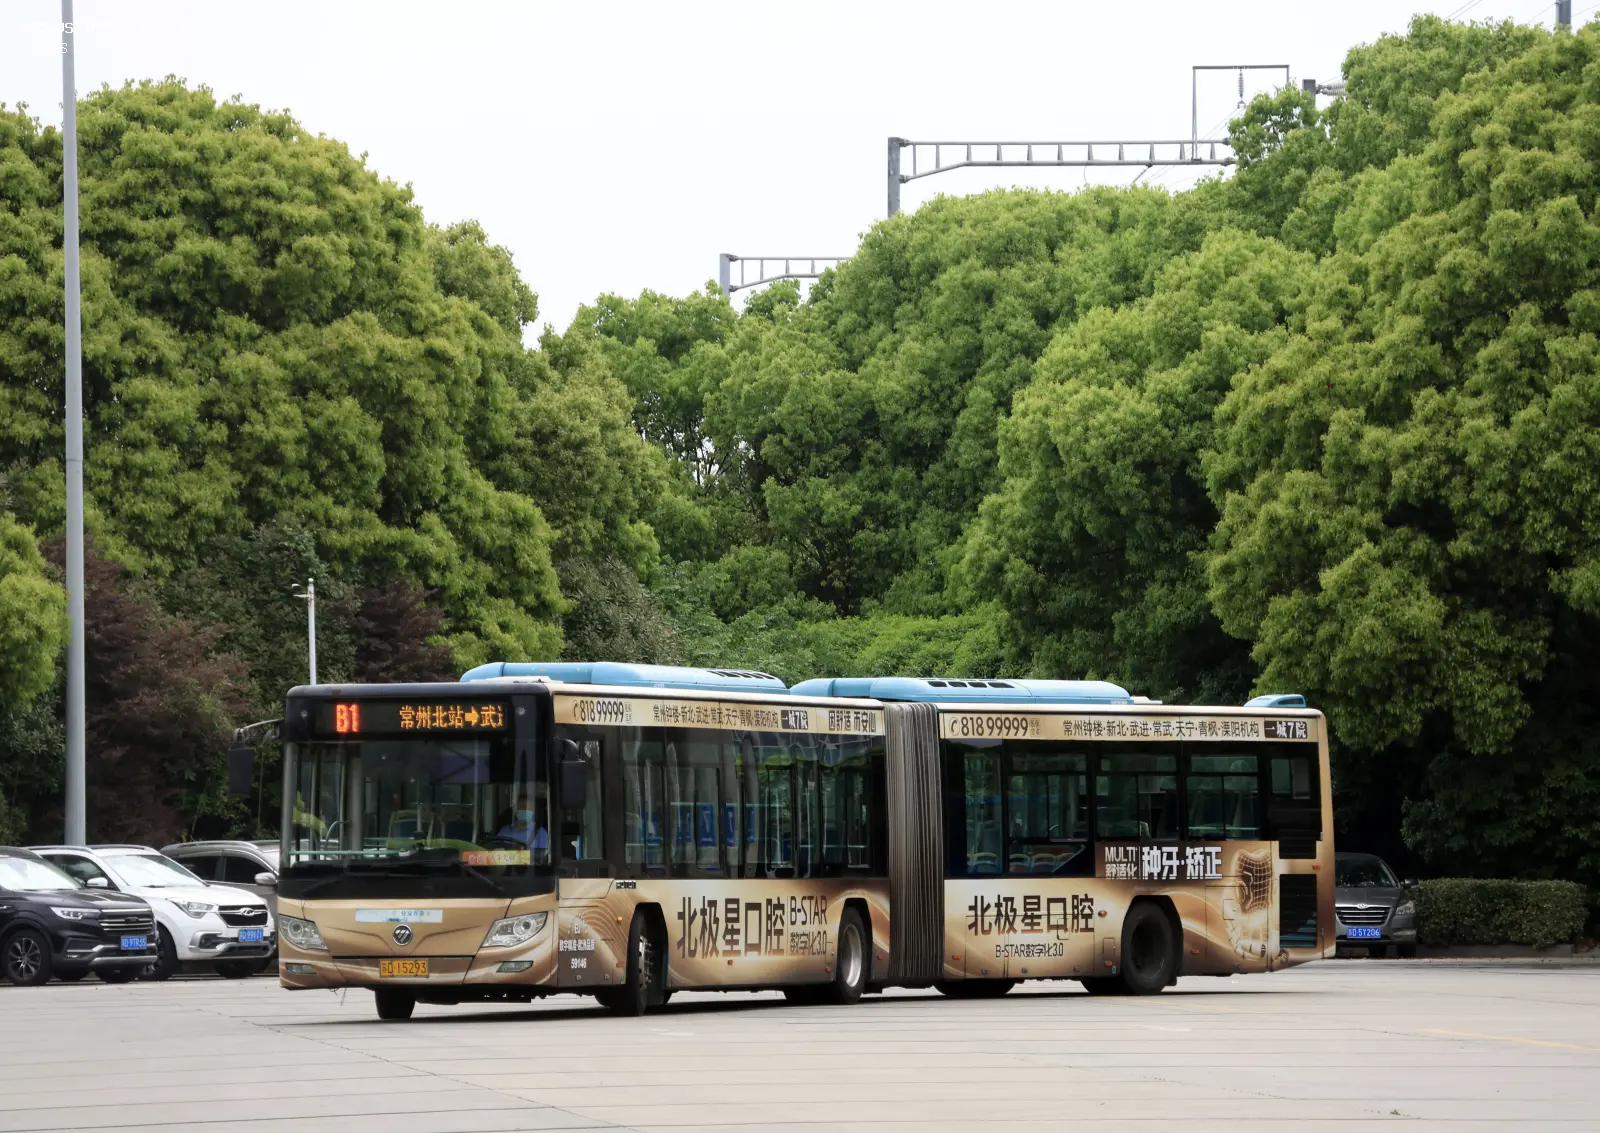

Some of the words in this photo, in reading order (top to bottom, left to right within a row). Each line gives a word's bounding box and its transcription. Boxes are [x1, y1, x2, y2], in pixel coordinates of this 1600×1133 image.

[336, 704, 360, 733] B1
[399, 705, 464, 729] 常州北站
[1265, 721, 1307, 738] 一城7院
[1105, 863, 1138, 880] 舒适化
[789, 895, 828, 926] B-STAR
[968, 892, 1095, 936] 北极星口腔
[676, 895, 786, 959] 北极星口腔
[789, 930, 827, 956] 数字化3.0
